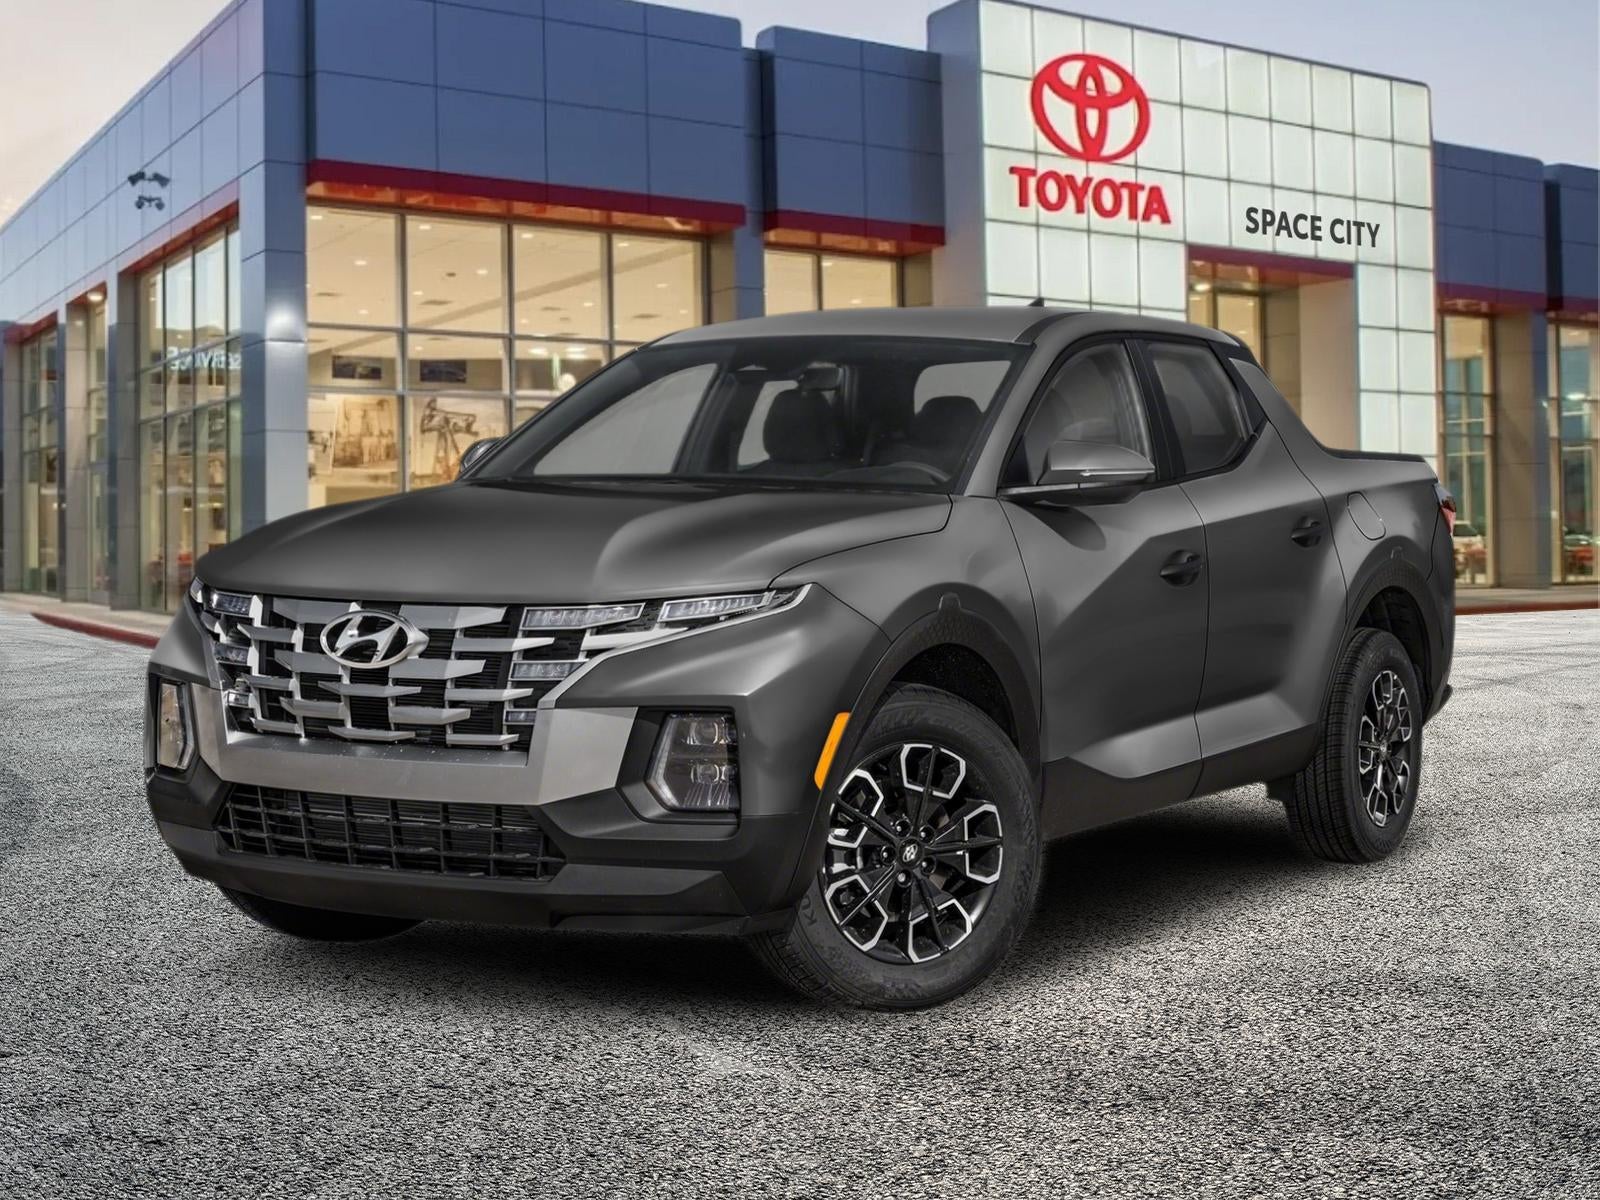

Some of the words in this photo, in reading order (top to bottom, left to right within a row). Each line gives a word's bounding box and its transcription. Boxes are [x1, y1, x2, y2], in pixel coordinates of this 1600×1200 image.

[1009, 166, 1171, 224] TOYOTA
[1245, 206, 1323, 241] SPACE
[1329, 218, 1380, 248] CITY
